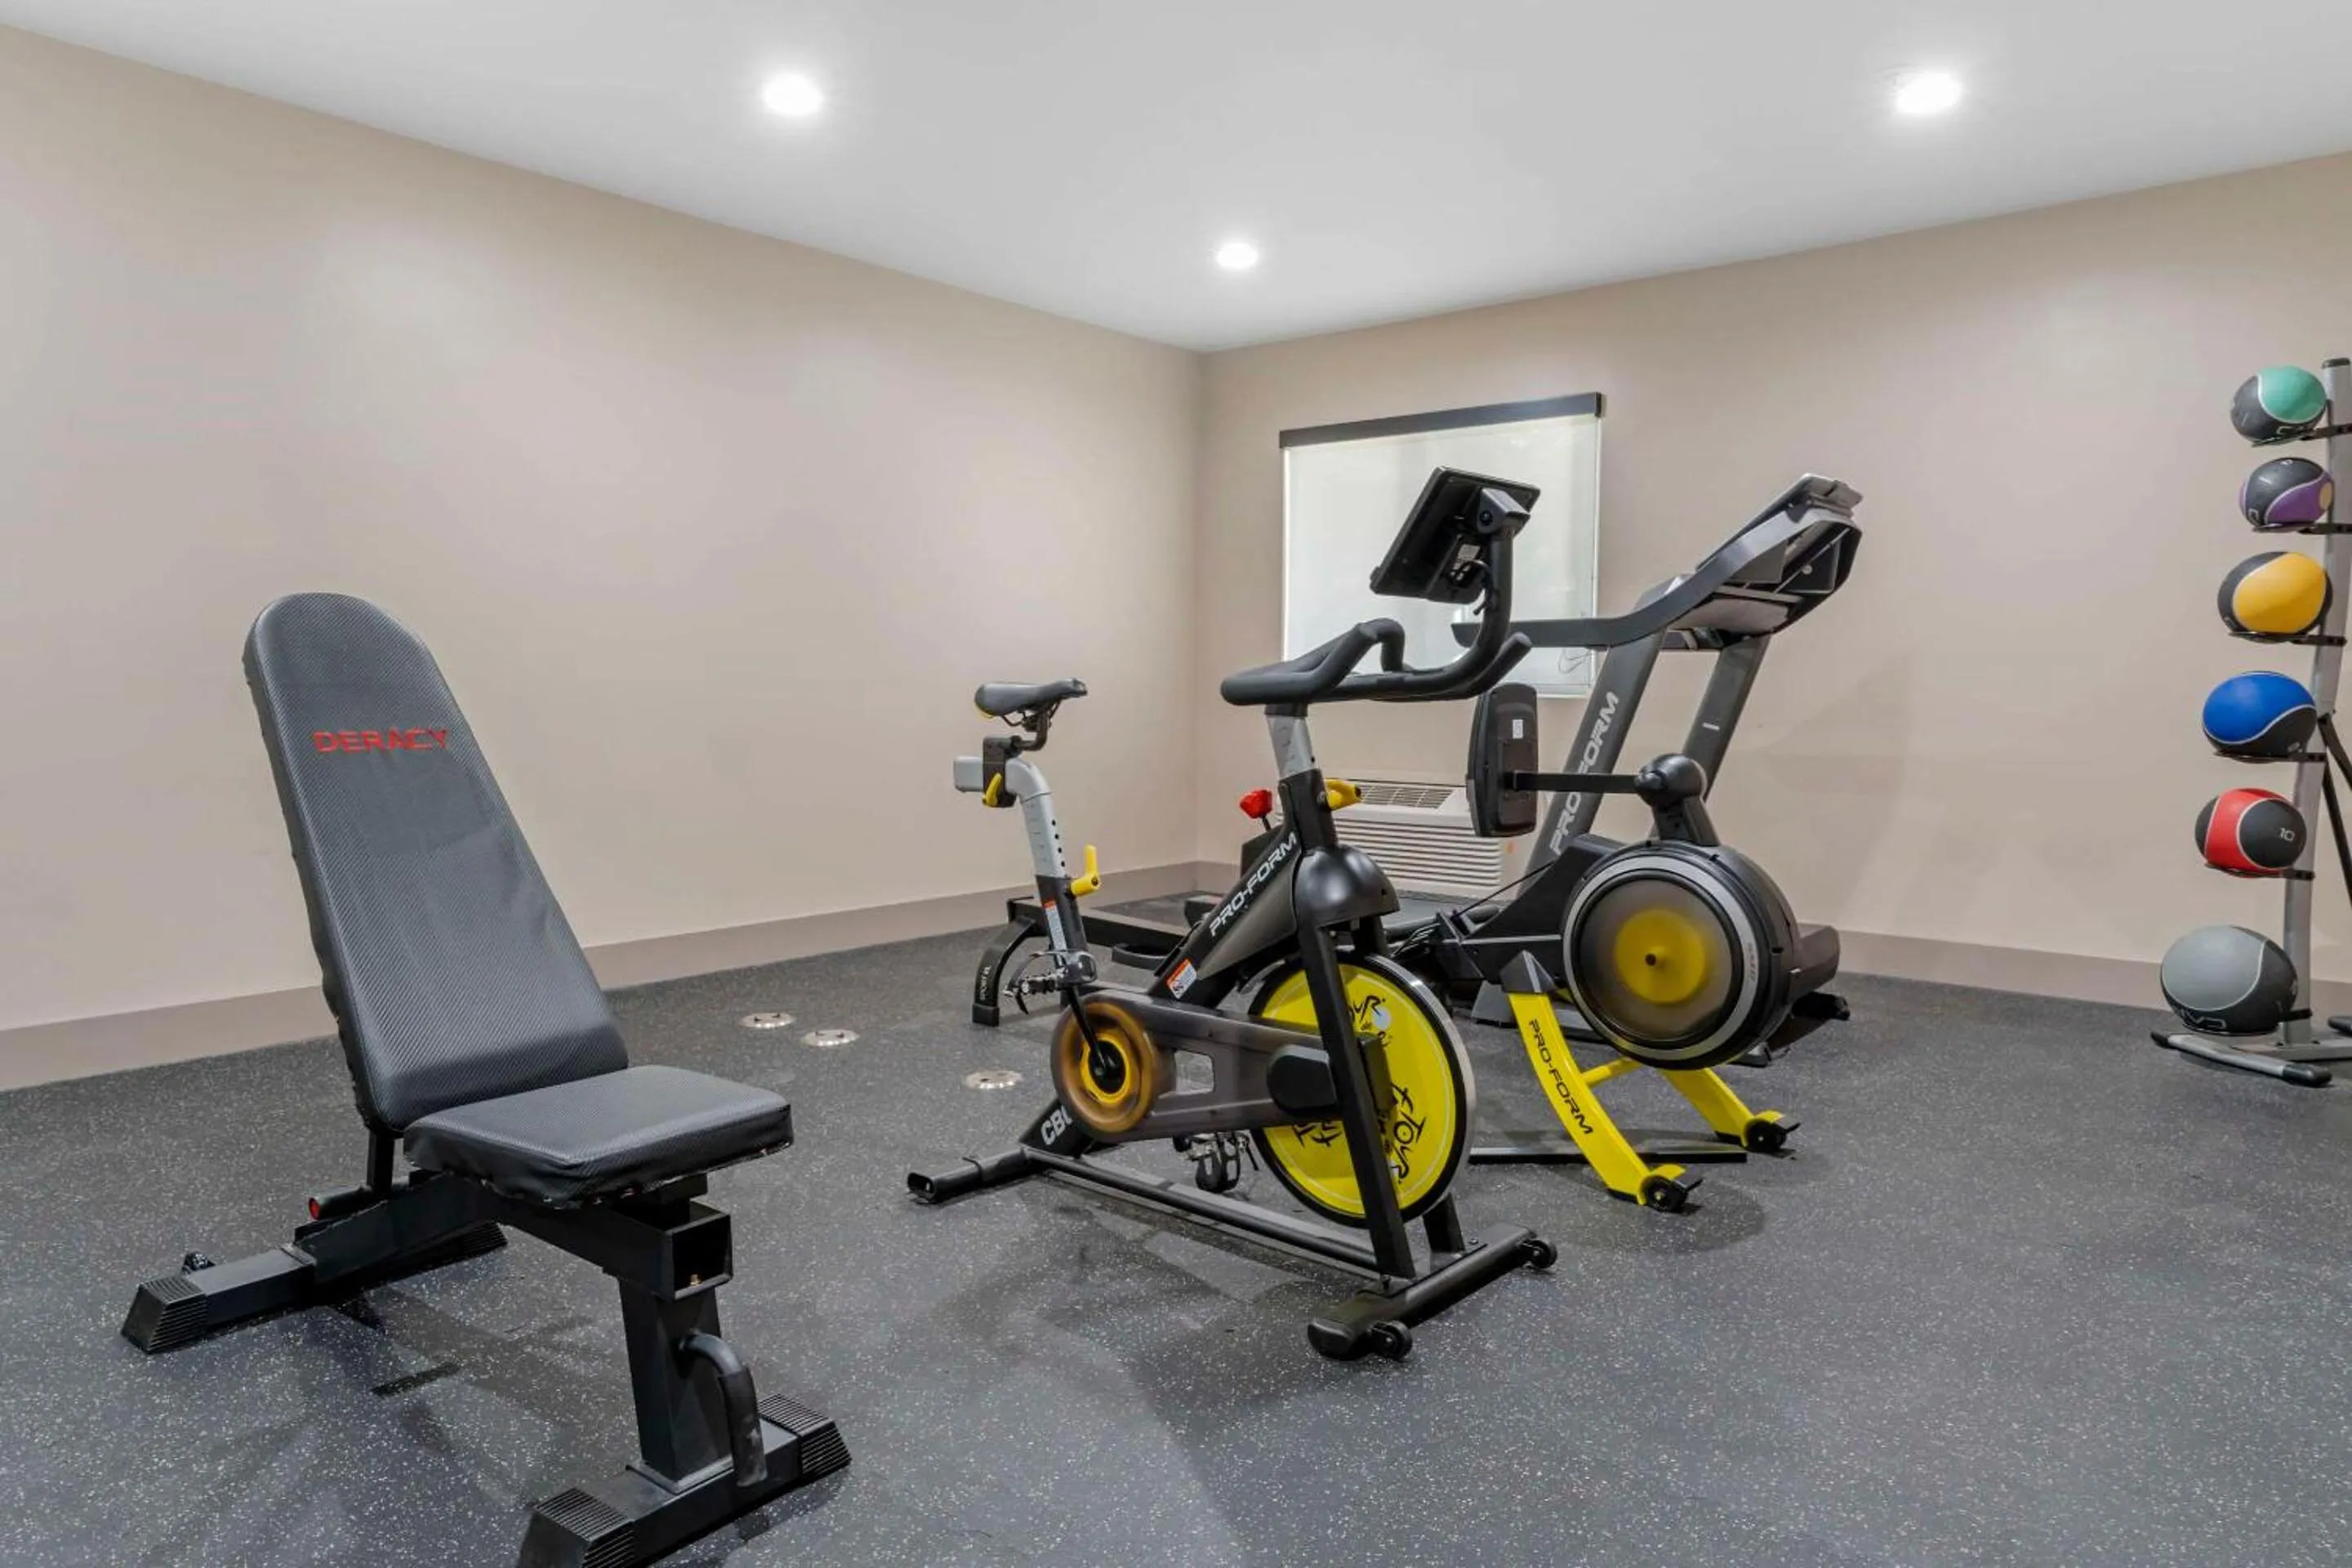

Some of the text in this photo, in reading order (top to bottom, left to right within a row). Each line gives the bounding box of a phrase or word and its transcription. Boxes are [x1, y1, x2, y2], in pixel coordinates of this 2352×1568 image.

[313, 725, 448, 754] DERACY
[1209, 831, 1297, 938] PRO-FORM
[1529, 1018, 1594, 1135] PRO-FORM
